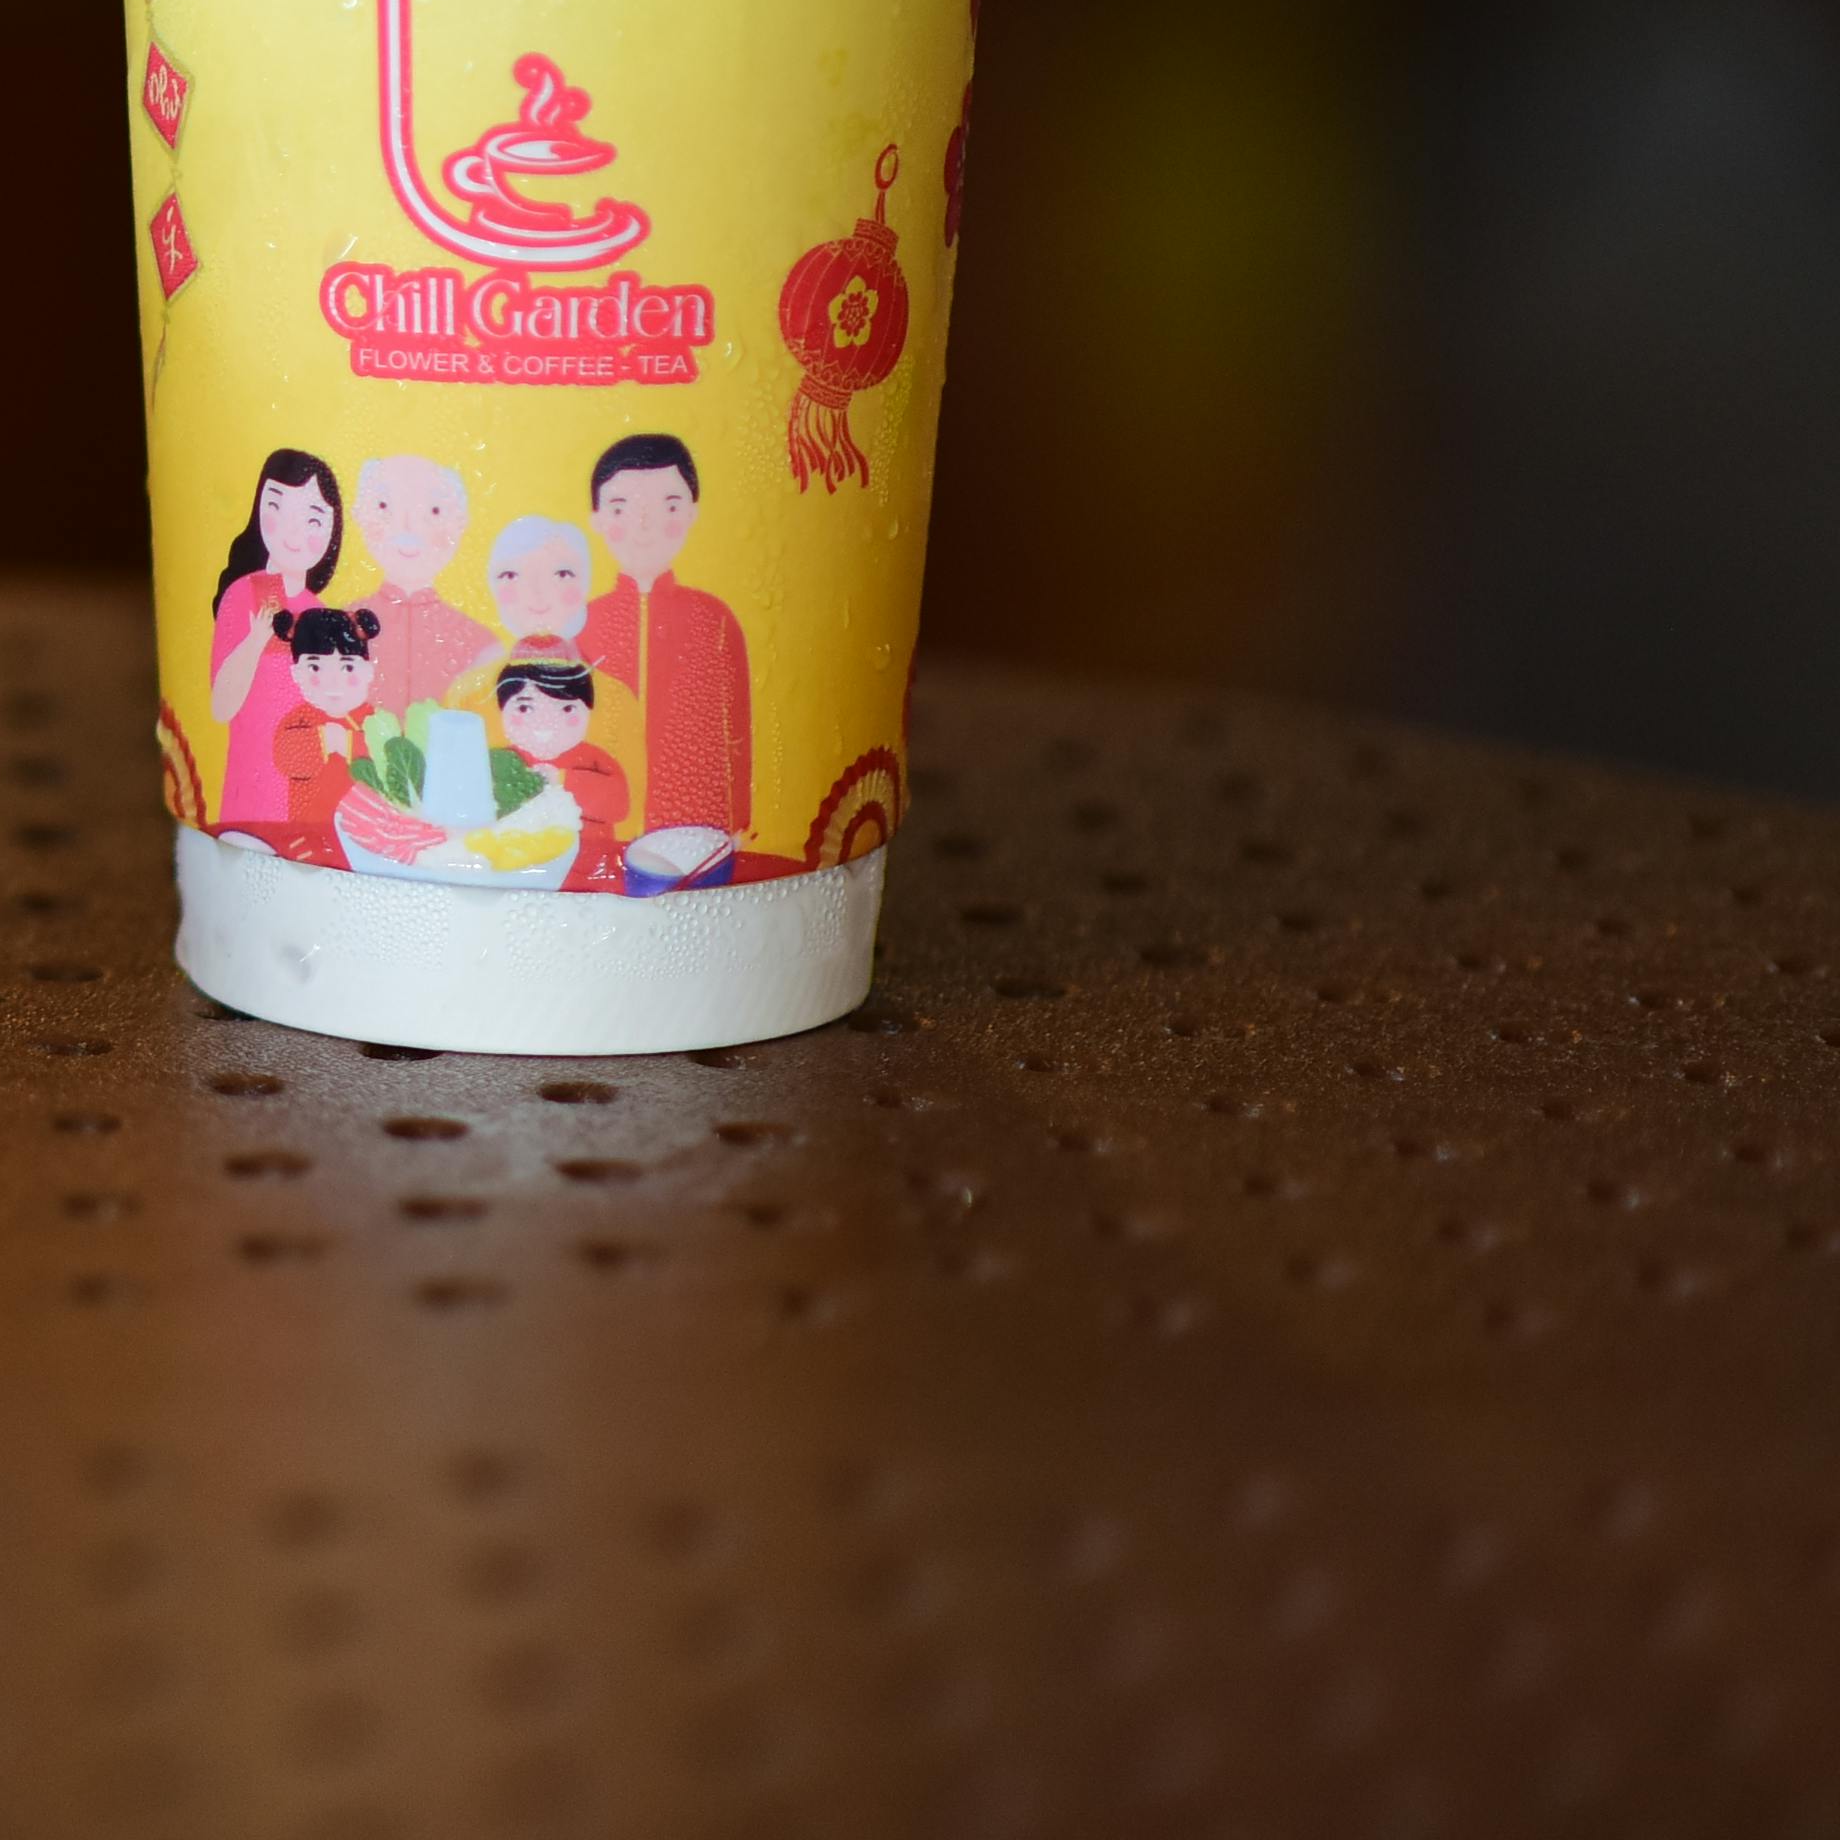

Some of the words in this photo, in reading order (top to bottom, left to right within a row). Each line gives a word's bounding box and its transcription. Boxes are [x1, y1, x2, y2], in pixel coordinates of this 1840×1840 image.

[327, 270, 457, 336] Chill
[471, 277, 707, 340] Garden
[358, 347, 470, 375] FLOWER
[478, 353, 496, 375] &
[503, 354, 615, 376] COFFEE
[639, 354, 690, 375] TEA
